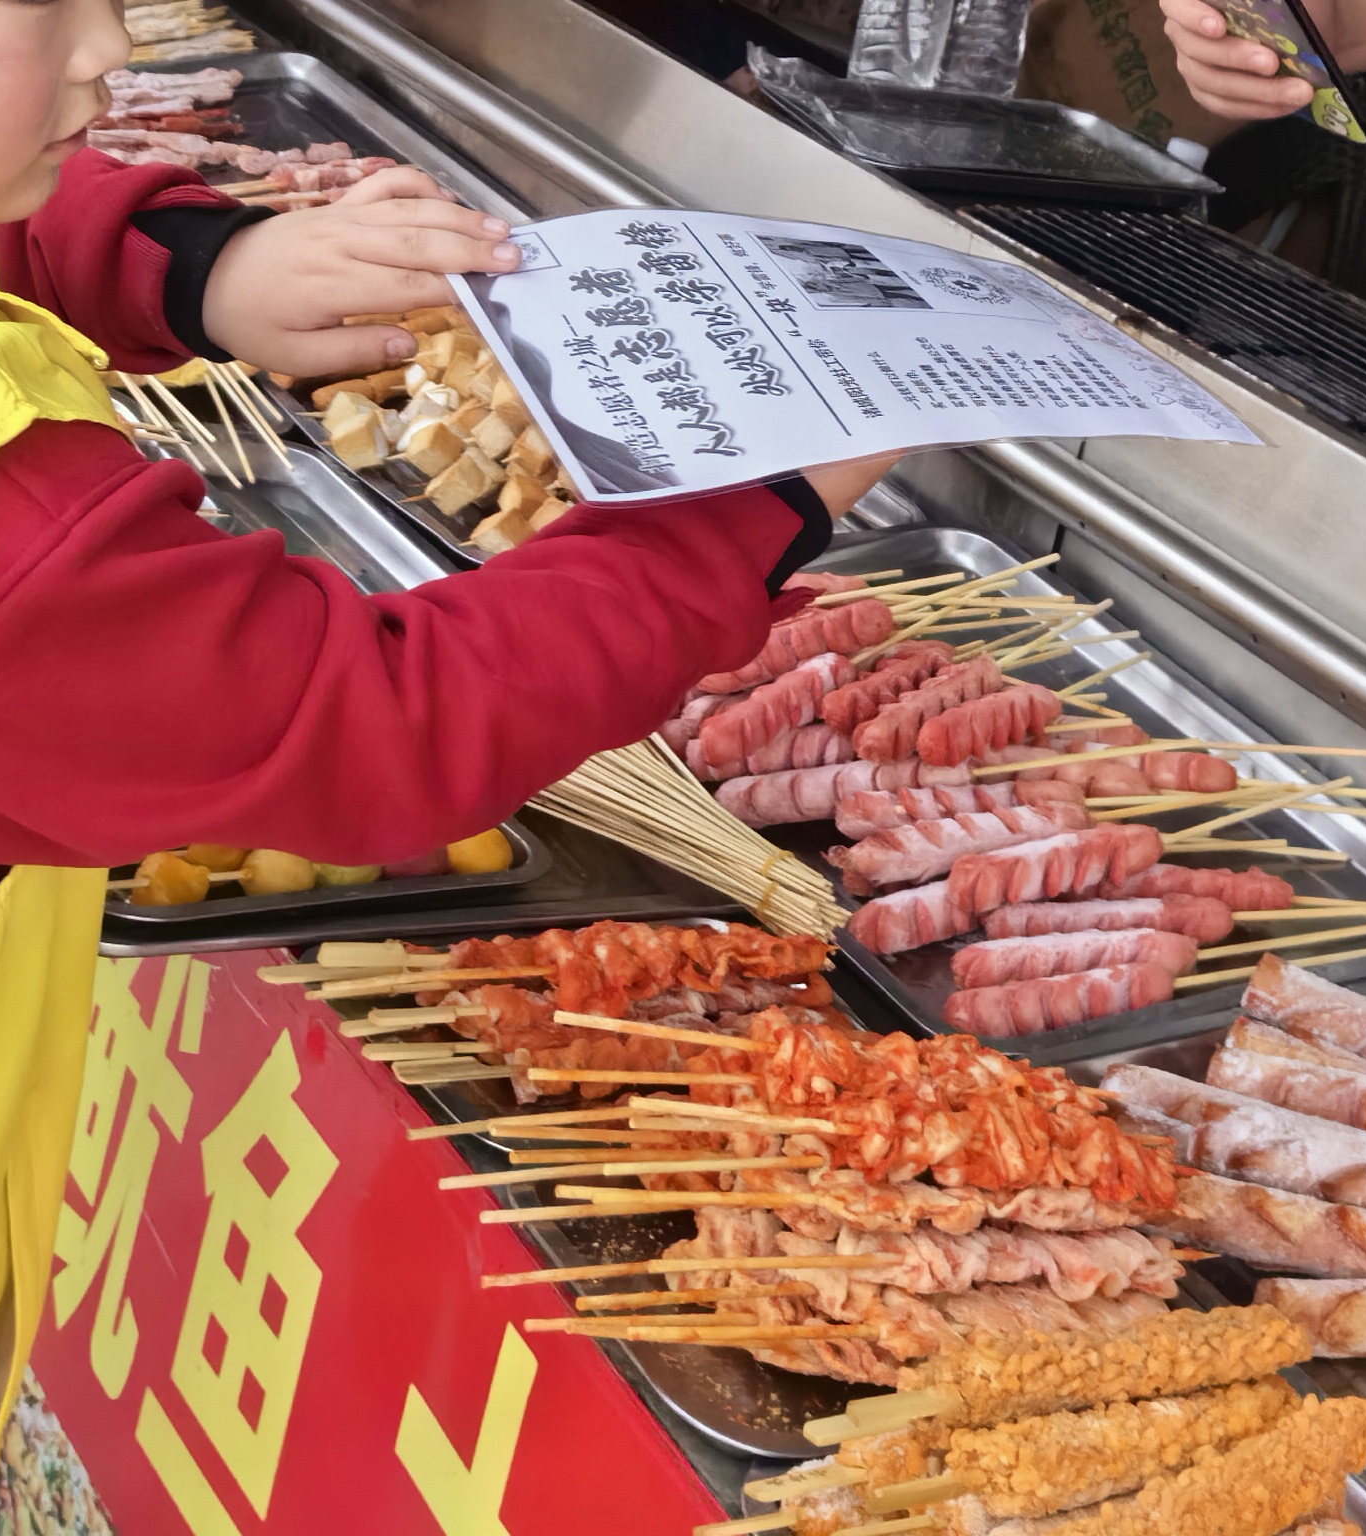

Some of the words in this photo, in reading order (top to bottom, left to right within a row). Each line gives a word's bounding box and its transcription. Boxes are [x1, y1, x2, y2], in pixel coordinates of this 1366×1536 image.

[570, 266, 746, 457] 人人都是志愿者
[615, 219, 792, 396] 处处可以学雷锋
